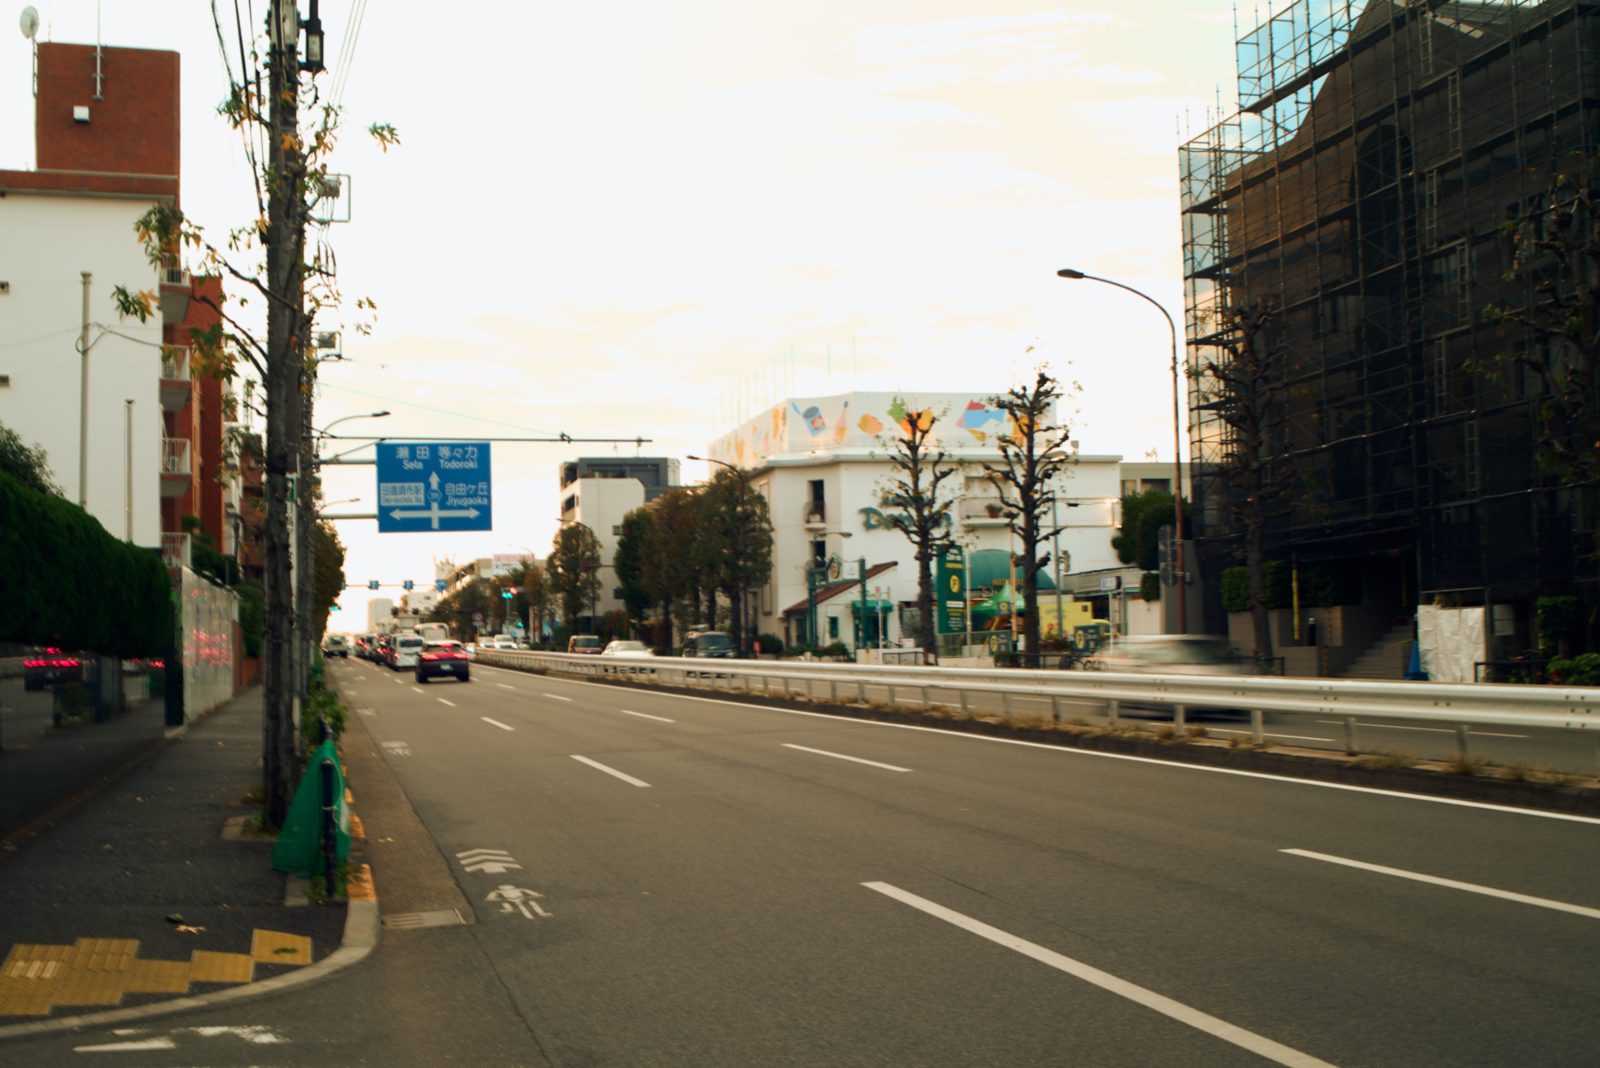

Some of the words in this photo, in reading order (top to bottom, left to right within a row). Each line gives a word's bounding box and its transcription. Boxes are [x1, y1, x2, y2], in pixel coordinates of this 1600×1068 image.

[403, 460, 423, 470] Seta
[439, 459, 477, 469] Todoroki
[445, 495, 488, 506] Jiyugaoka
